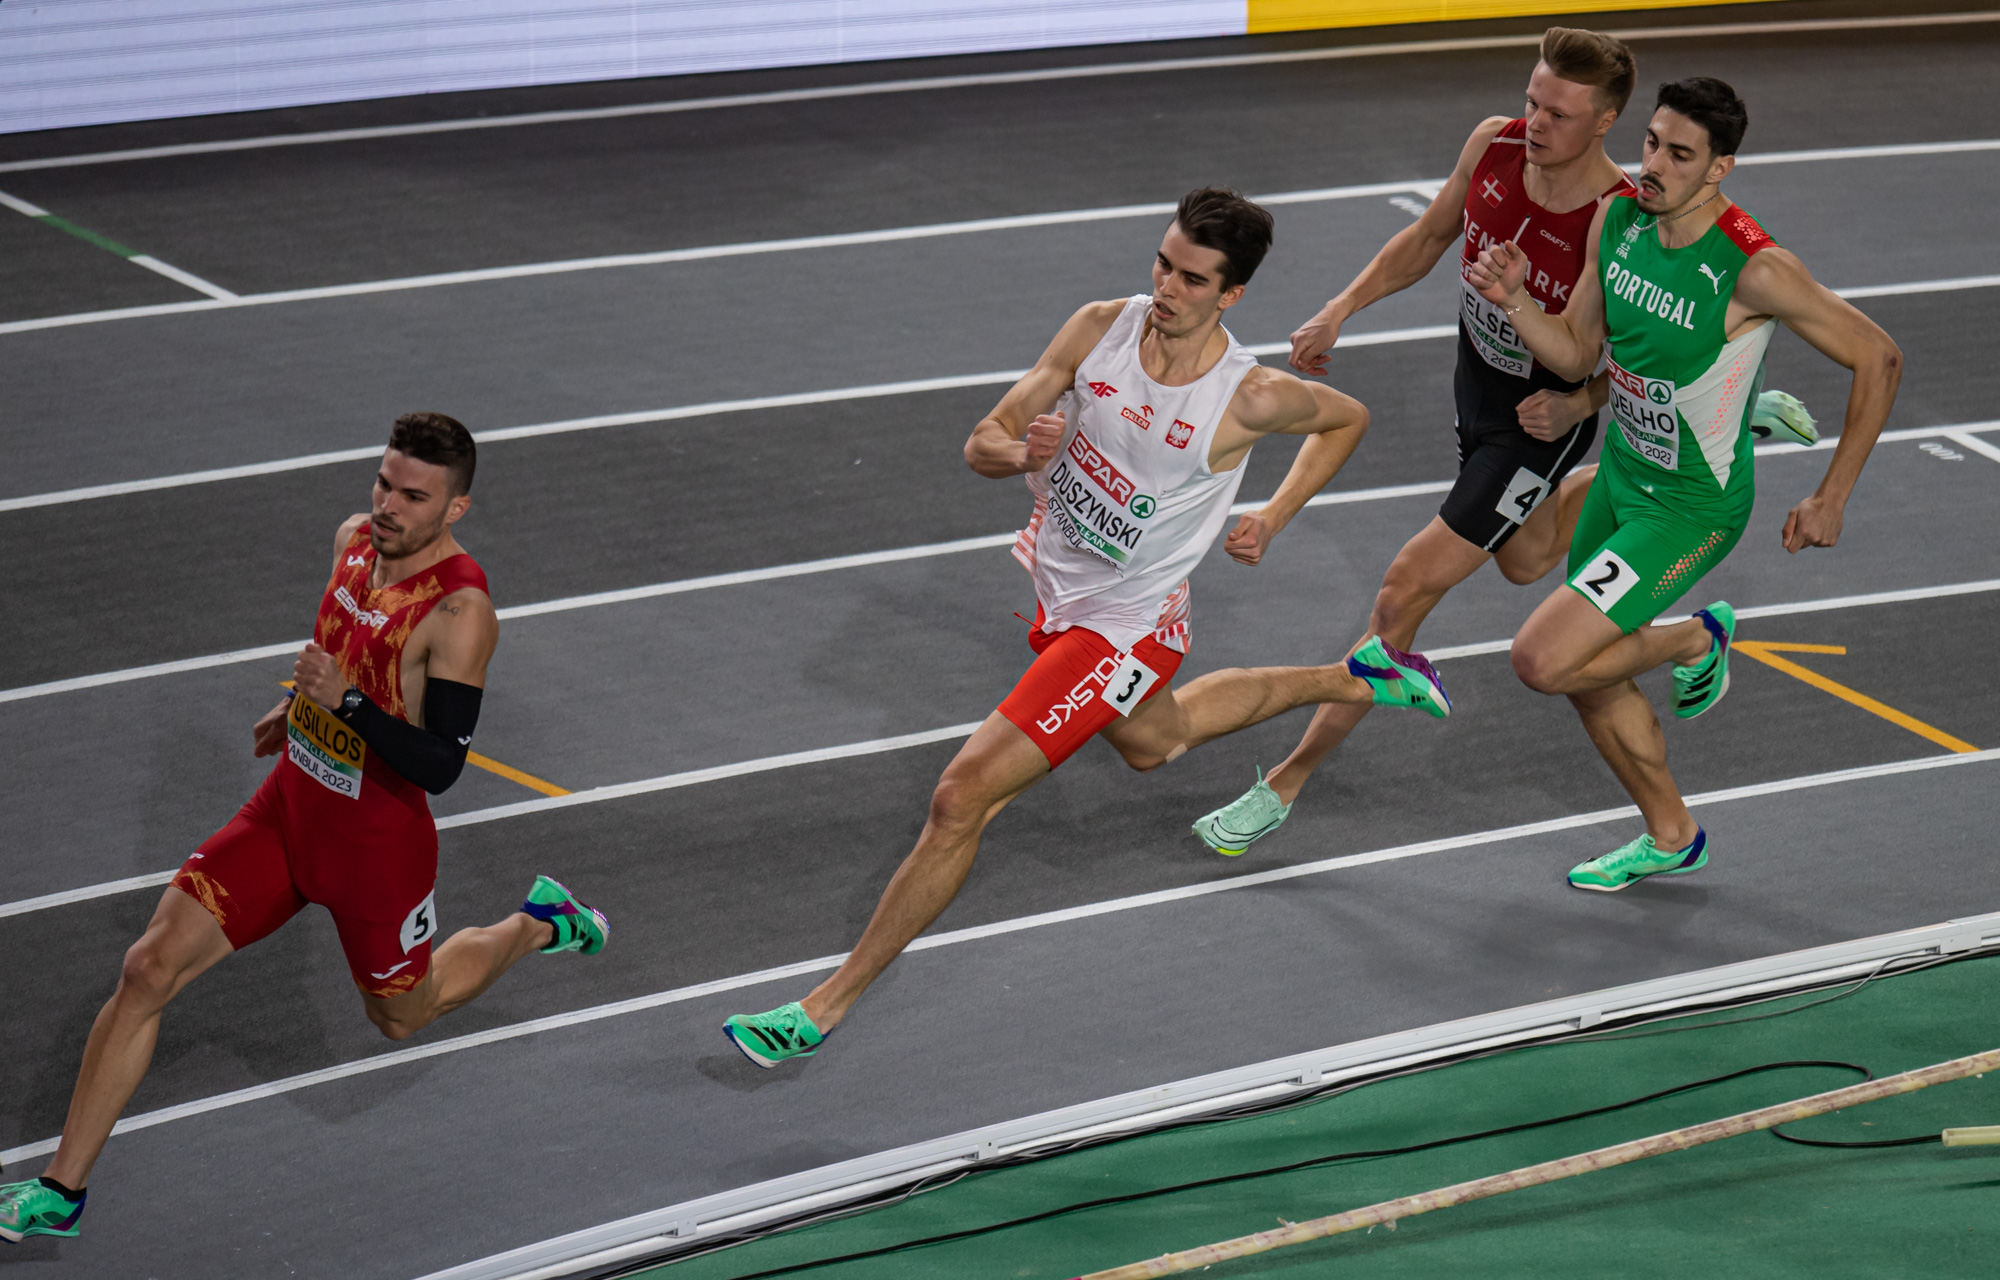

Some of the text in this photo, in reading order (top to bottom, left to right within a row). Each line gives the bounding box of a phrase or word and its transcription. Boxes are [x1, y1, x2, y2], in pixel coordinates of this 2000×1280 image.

[1540, 229, 1566, 248] CRAFT
[1615, 246, 1628, 260] FPA
[1605, 260, 1696, 331] PORTUGAL
[1477, 331, 1505, 354] CLEAN
[1490, 353, 1523, 373] 2023
[1088, 381, 1119, 398] 4F
[1122, 409, 1149, 430] ORLEN
[1630, 425, 1656, 443] CLEAN
[1070, 435, 1132, 503] SPAR
[1644, 445, 1672, 465] 2023
[1050, 461, 1143, 550] DUSZYNSKI
[1514, 485, 1542, 518] 4
[1075, 522, 1106, 549] CLEAN
[1585, 560, 1620, 597] 2
[1116, 669, 1143, 703] 3
[295, 731, 310, 750] RUN
[310, 744, 336, 769] CLEAN
[289, 741, 353, 793] ANBUL 2023
[413, 904, 429, 941] 5
